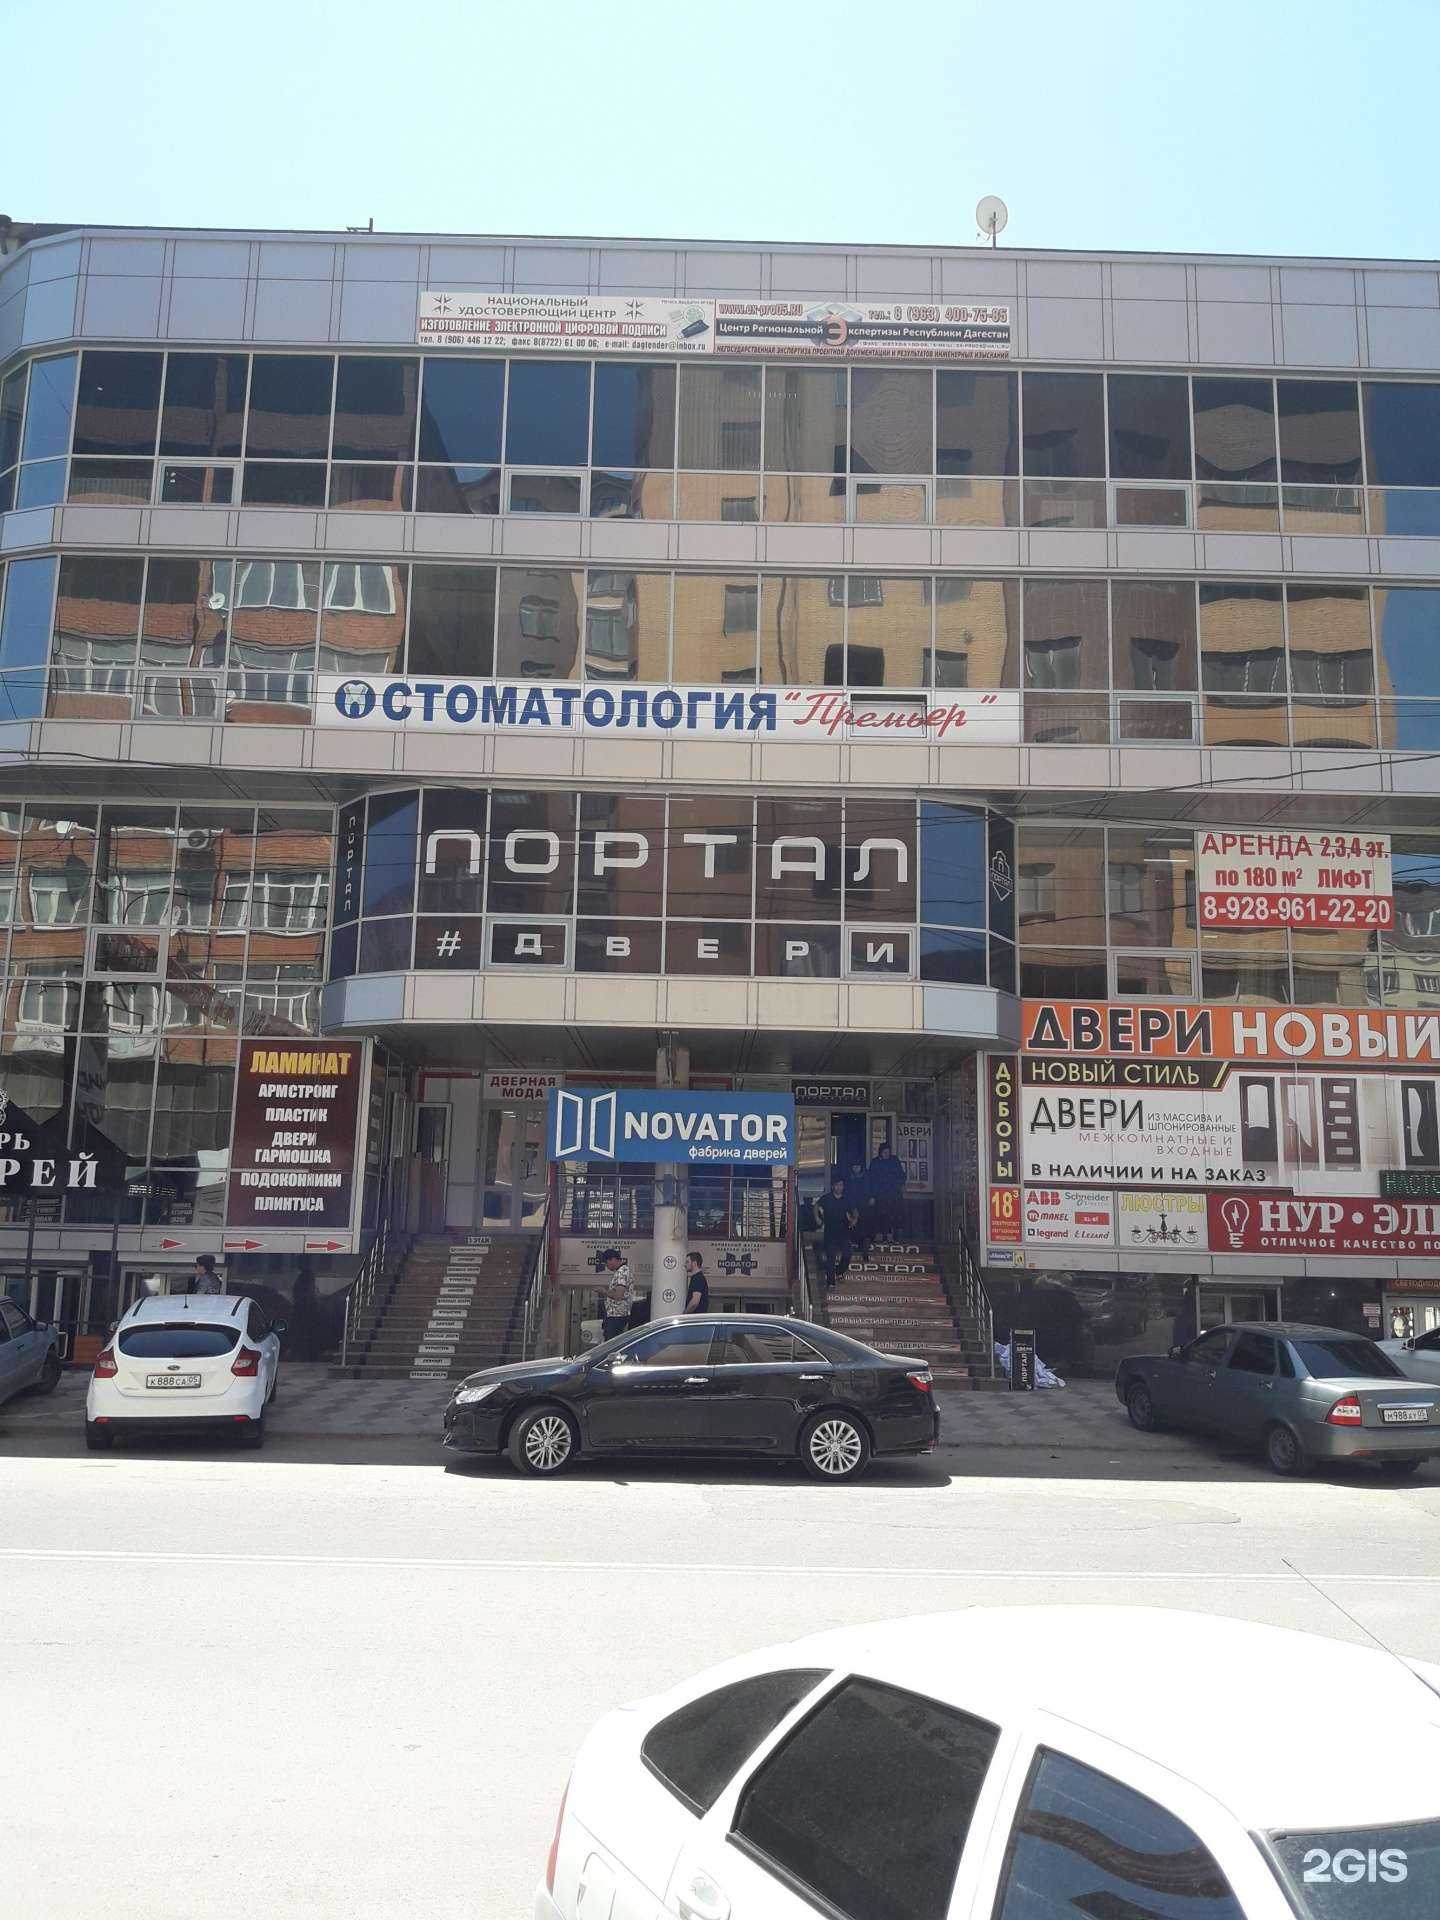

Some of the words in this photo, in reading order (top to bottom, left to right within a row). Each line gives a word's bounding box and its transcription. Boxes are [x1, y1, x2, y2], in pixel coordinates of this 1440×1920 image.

[487, 296, 588, 307] НАЦИОНАЛЬНЫЙ
[458, 306, 578, 318] УДОСТОВЕРЯЮЩИЙ
[580, 309, 616, 319] ЦЕНТР
[894, 306, 902, 320] 8
[421, 319, 491, 331] ИЗГОТОВЛЕНИЕ
[494, 320, 561, 333] ЭЛЕКТРОННОЙ
[565, 321, 619, 335] ЦИФРОВОЙ
[622, 323, 667, 336] ПОДПИСИ
[720, 324, 749, 333] Центр
[752, 323, 823, 334] Региональной
[903, 327, 961, 339] Республики
[963, 329, 1008, 339] Дагестан
[437, 335, 442, 343] 8
[483, 336, 491, 344] 12
[511, 337, 530, 346] факс
[381, 682, 777, 731] СТОМАТОЛОГИЯ
[1201, 834, 1313, 860] АРЕНДА
[1320, 837, 1361, 860] 2,3,4
[1365, 841, 1389, 859] эт.
[425, 828, 909, 884] ПОРТАЛ
[1215, 870, 1238, 887] по
[1243, 867, 1277, 888] 180
[1318, 868, 1372, 889] ЛИФТ
[1203, 896, 1391, 924] 8-928-961-22-20
[1026, 1006, 1213, 1055] ДВЕРИ
[1232, 1011, 1440, 1060] НОВЫЙ
[250, 1051, 351, 1075] ЛАМИНАТ
[1032, 1058, 1116, 1084] НОВЫЙ
[1124, 1064, 1200, 1087] СТИЛЬ
[490, 1076, 556, 1088] ДВЕРНАЯ
[258, 1084, 338, 1099] АРМСТРОНГ
[502, 1087, 544, 1099] МОДА
[795, 1086, 867, 1097] ПОРТАЛ
[265, 1108, 328, 1122] ПЛАСТИК
[995, 1062, 1013, 1178] ДОБОРЫ
[1030, 1097, 1144, 1133] ДВЕРИ
[1148, 1113, 1161, 1121] ИЗ
[1163, 1113, 1213, 1122] МАССИВА
[624, 1112, 788, 1143] NOVATOR
[1148, 1123, 1238, 1133] ШПОНИРОВАННЫЕ
[272, 1131, 317, 1147] ДВЕРИ
[1079, 1133, 1217, 1145] МЕЖКОМНАТНЫЕ
[1223, 1137, 1232, 1145] И
[254, 1149, 332, 1164] ГАРМОШКА
[688, 1145, 741, 1159] фабрика
[744, 1147, 788, 1161] дверей
[1157, 1145, 1233, 1158] ВХОДНЫЕ
[240, 1172, 342, 1188] ПОДОКОННИКИ
[1031, 1164, 1042, 1176] В
[1050, 1164, 1143, 1179] НАЛИЧИИ
[1151, 1166, 1164, 1180] И
[1171, 1168, 1198, 1181] НА
[1204, 1168, 1267, 1182] ЗАКАЗ
[254, 1196, 324, 1212] ПЛИНТУСА
[1026, 1190, 1061, 1205] ABB
[1064, 1191, 1111, 1202] Schneider
[1120, 1193, 1205, 1213] ЛЮСТРЫ
[1258, 1200, 1344, 1234] НУР
[1037, 1229, 1069, 1239] legrand
[1261, 1237, 1336, 1248] ОТЛИЧНОЕ
[1343, 1239, 1416, 1250] КАЧЕСТВО
[848, 1263, 925, 1273] ОРТАЛ
